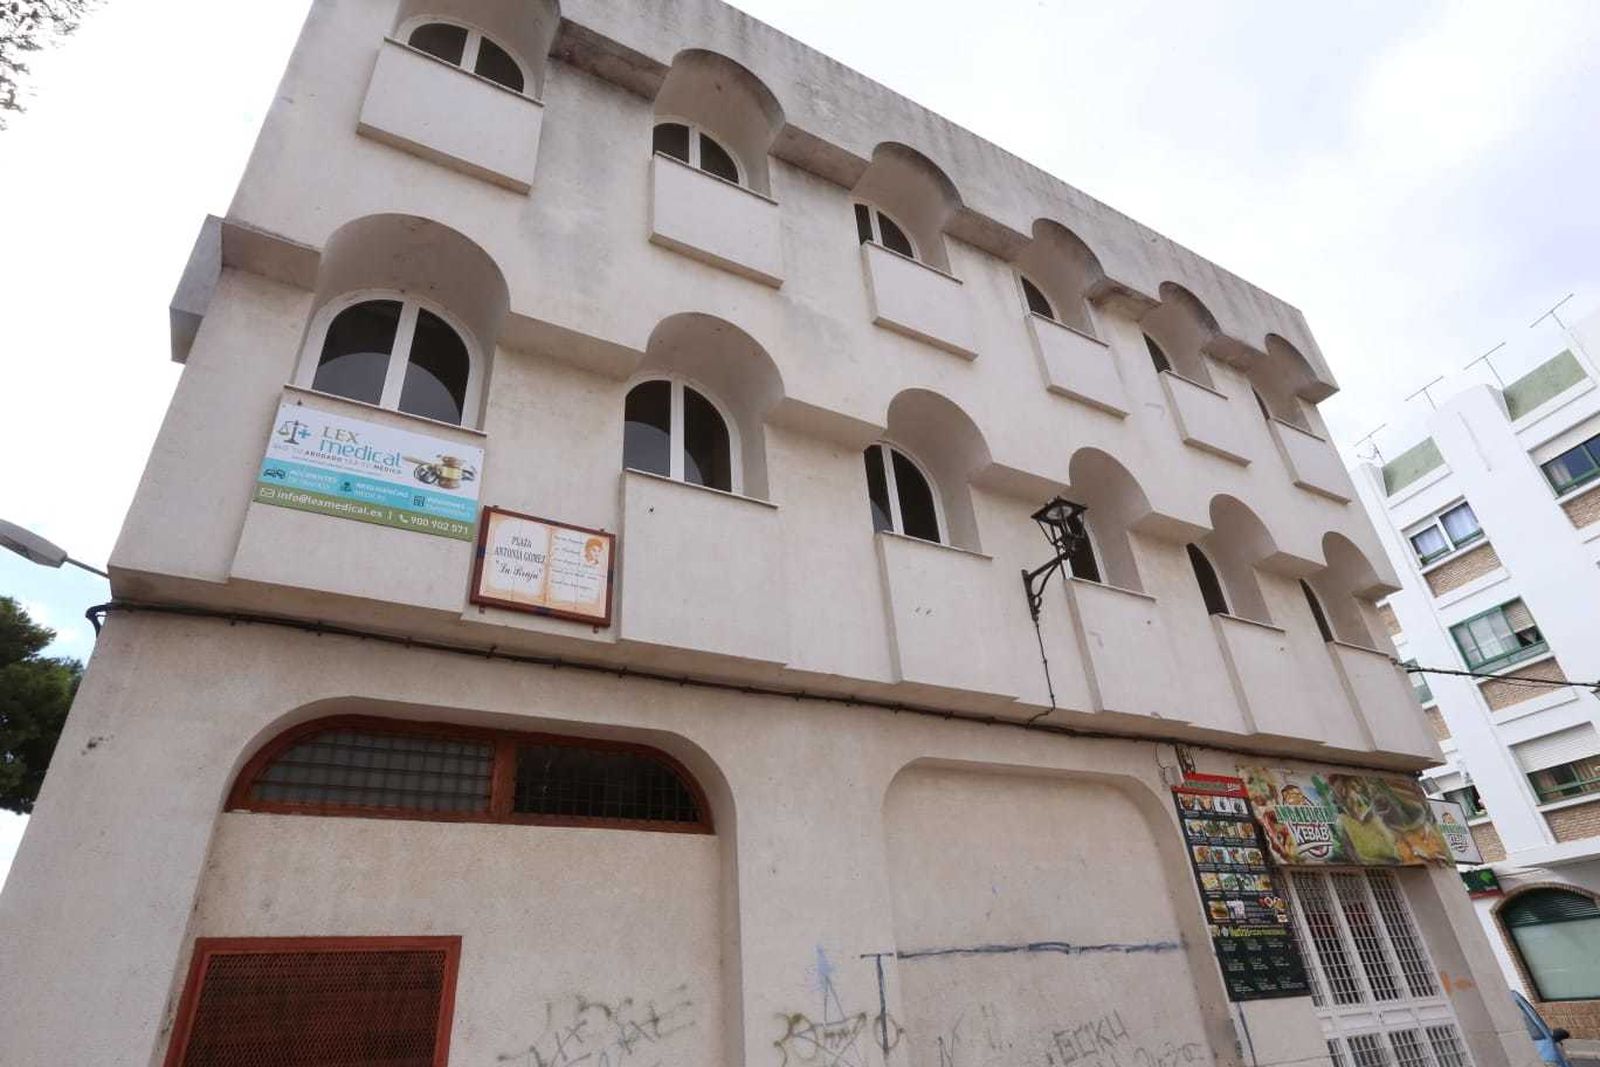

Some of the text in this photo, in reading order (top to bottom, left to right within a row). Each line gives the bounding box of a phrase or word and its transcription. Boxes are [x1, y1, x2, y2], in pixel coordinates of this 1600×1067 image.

[323, 425, 359, 444] LEX
[319, 438, 403, 469] medical
[1288, 821, 1331, 843] KEBAB
